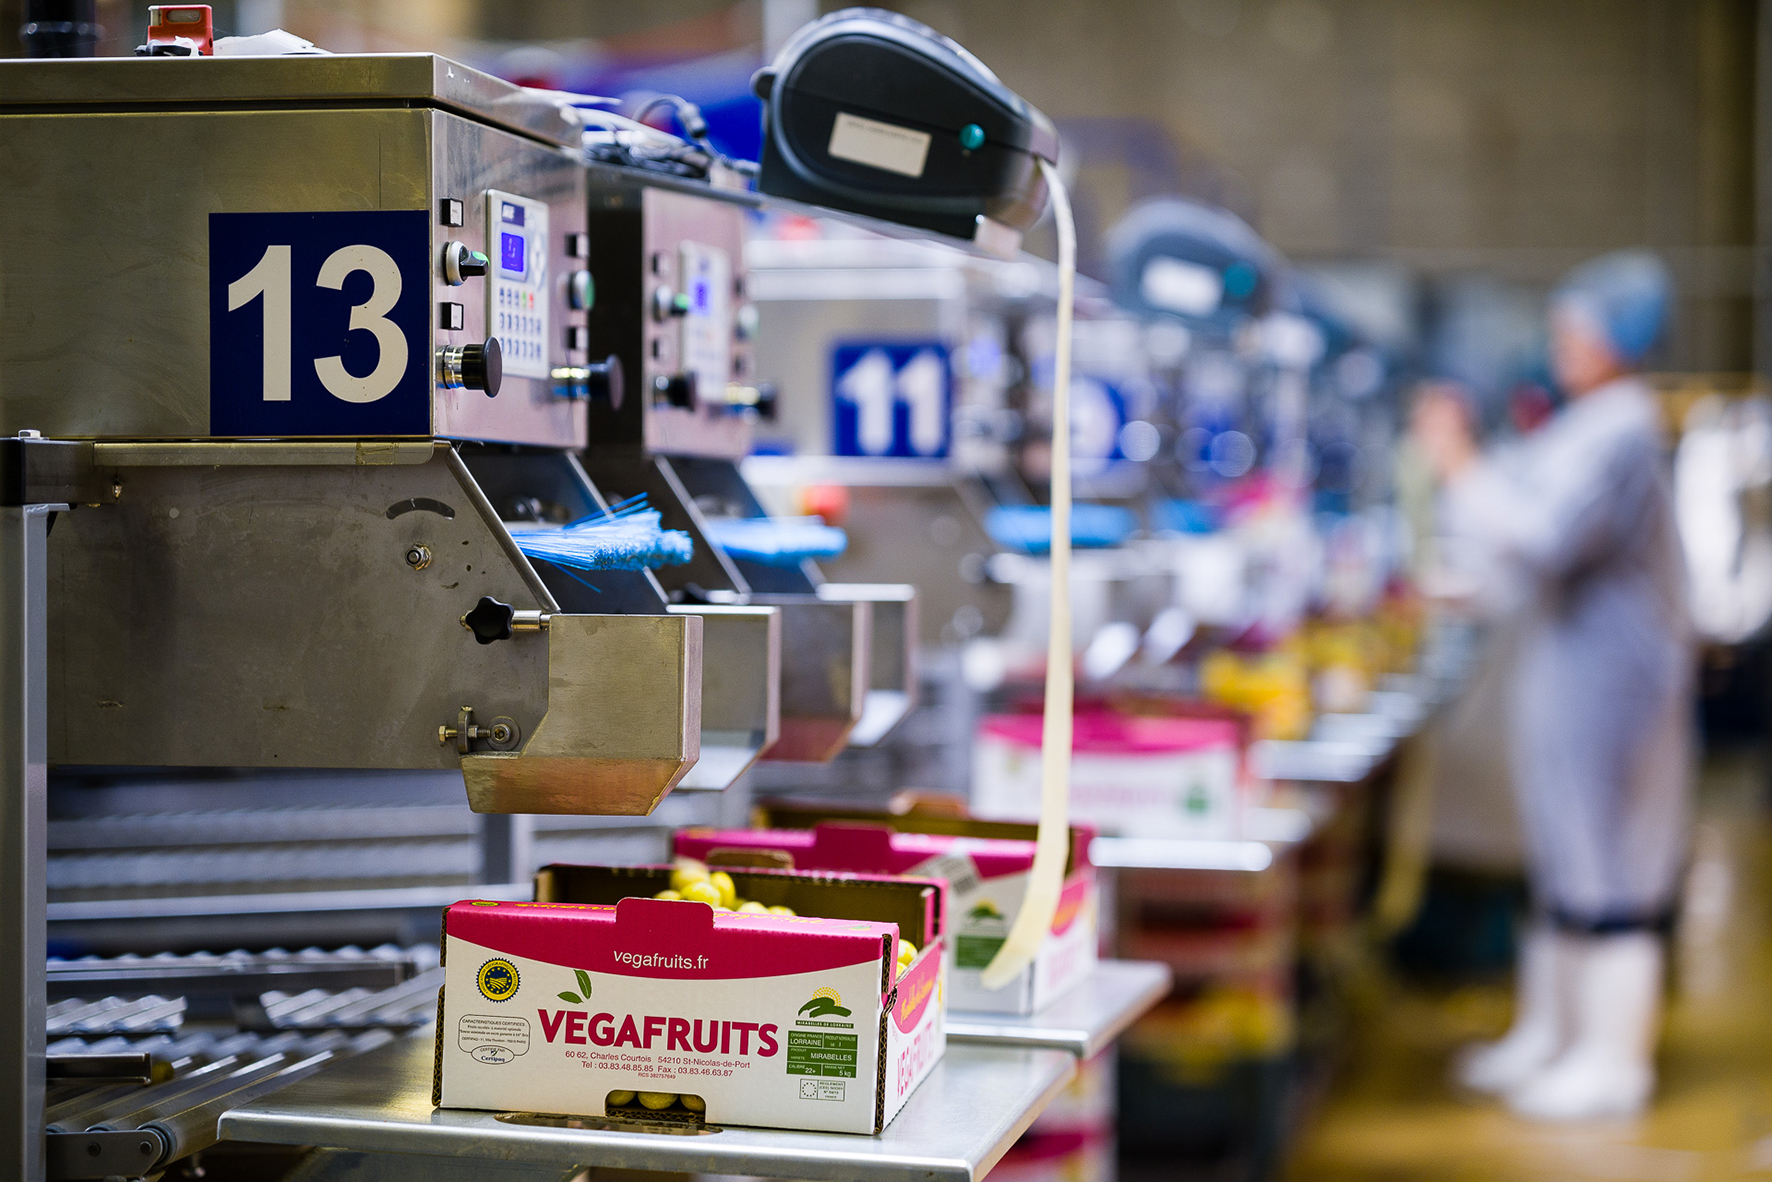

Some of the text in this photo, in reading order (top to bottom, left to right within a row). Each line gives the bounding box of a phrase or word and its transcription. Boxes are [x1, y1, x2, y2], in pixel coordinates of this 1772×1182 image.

[228, 244, 409, 404] 13
[836, 349, 942, 456] 11
[613, 950, 709, 970] vegafruits.fr
[537, 1008, 779, 1058] VEGAFRUITS
[576, 1051, 588, 1059] 62,
[590, 1052, 619, 1060] Charles
[620, 1054, 652, 1062] Courtois
[658, 1056, 681, 1064] 54210
[682, 1058, 750, 1069] St-Nicolas-de-Port
[810, 1052, 852, 1061] MIRABELLES
[598, 1062, 654, 1072] 03.83.48.85.85
[678, 1066, 733, 1077] 03.83.46.63.87
